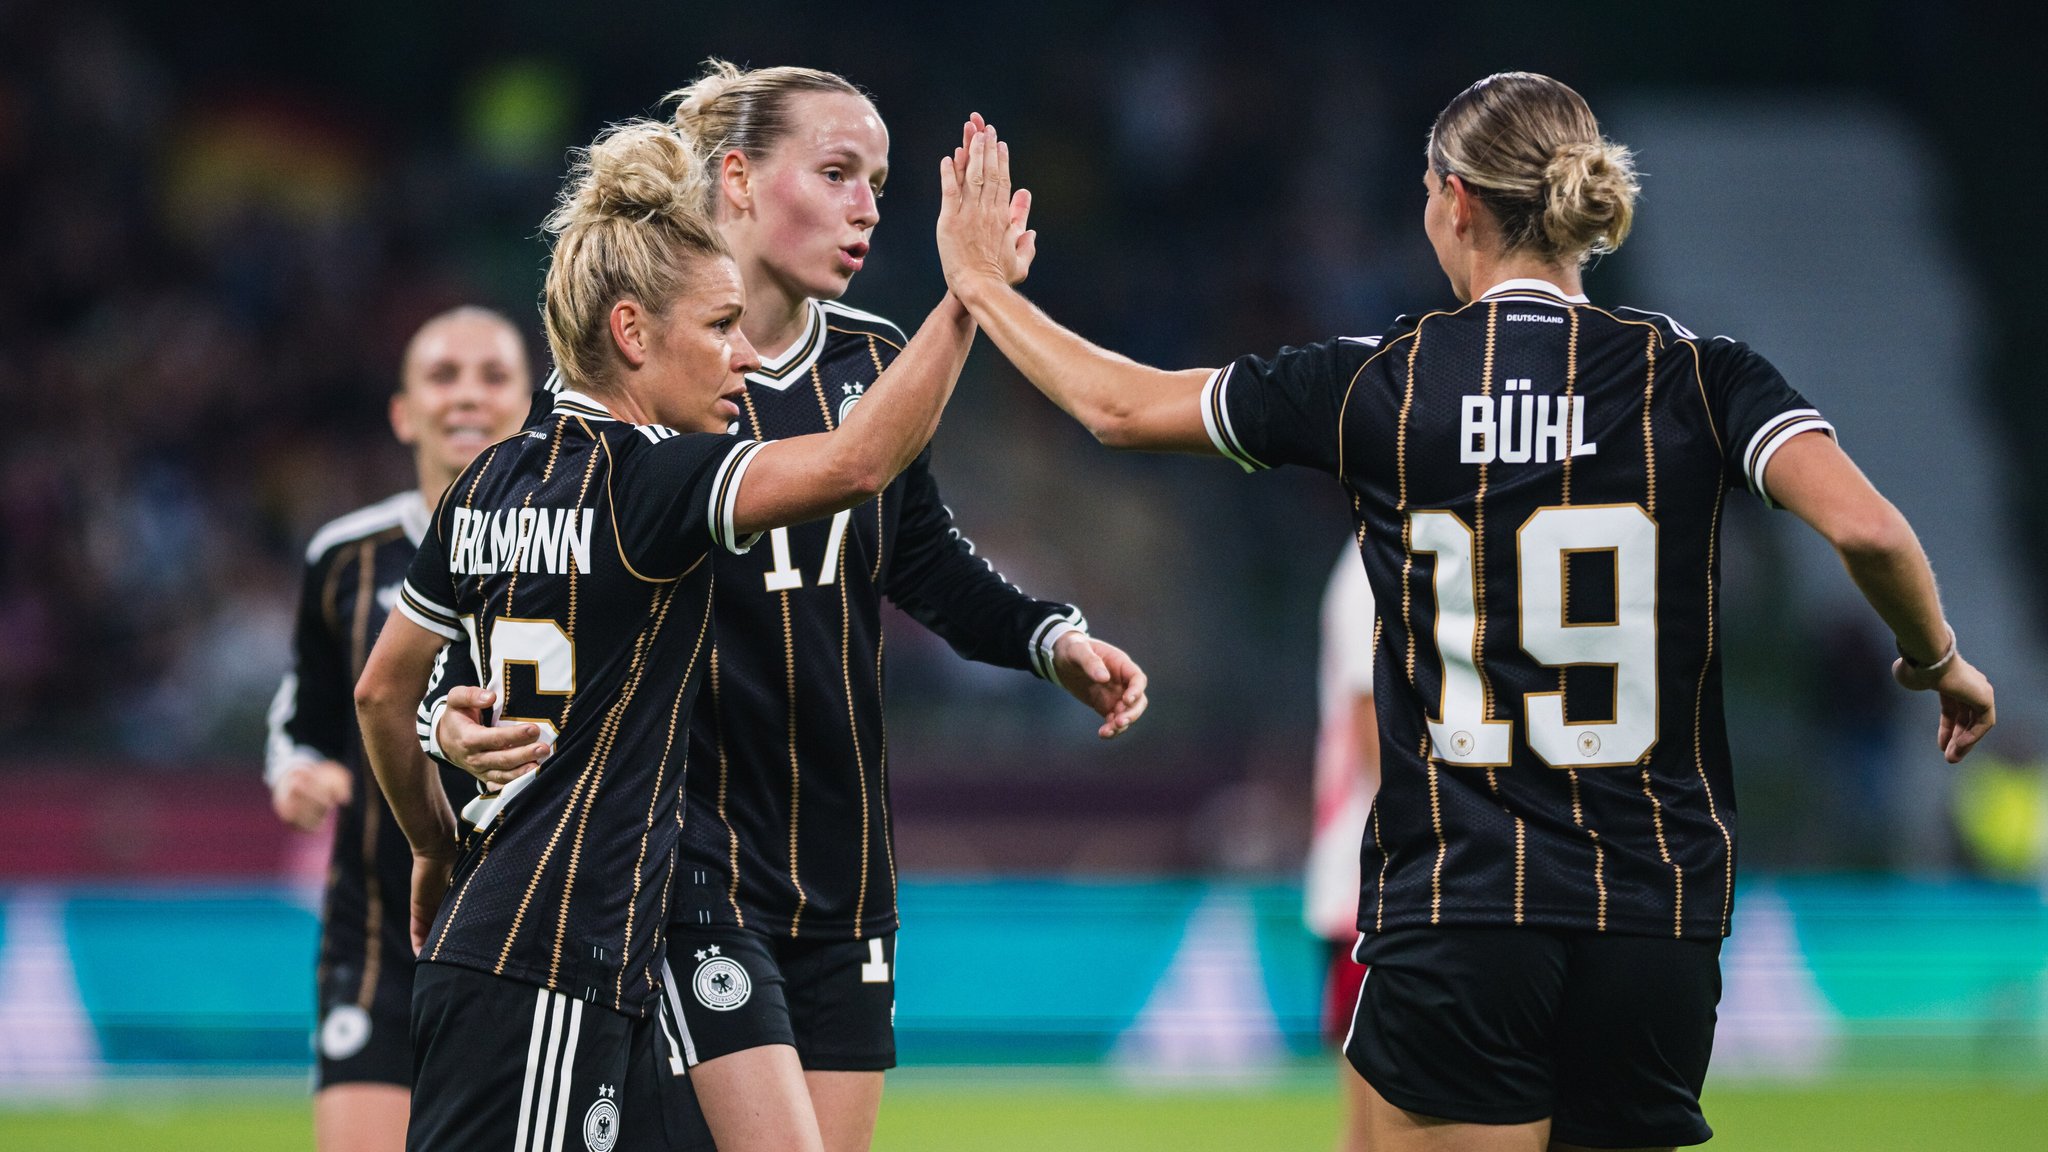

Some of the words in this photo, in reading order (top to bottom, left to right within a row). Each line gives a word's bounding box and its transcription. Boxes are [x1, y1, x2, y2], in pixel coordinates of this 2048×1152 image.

[1506, 314, 1564, 324] DEUTSCHLAND
[1460, 379, 1597, 463] BÜHL
[1409, 502, 1659, 768] 19
